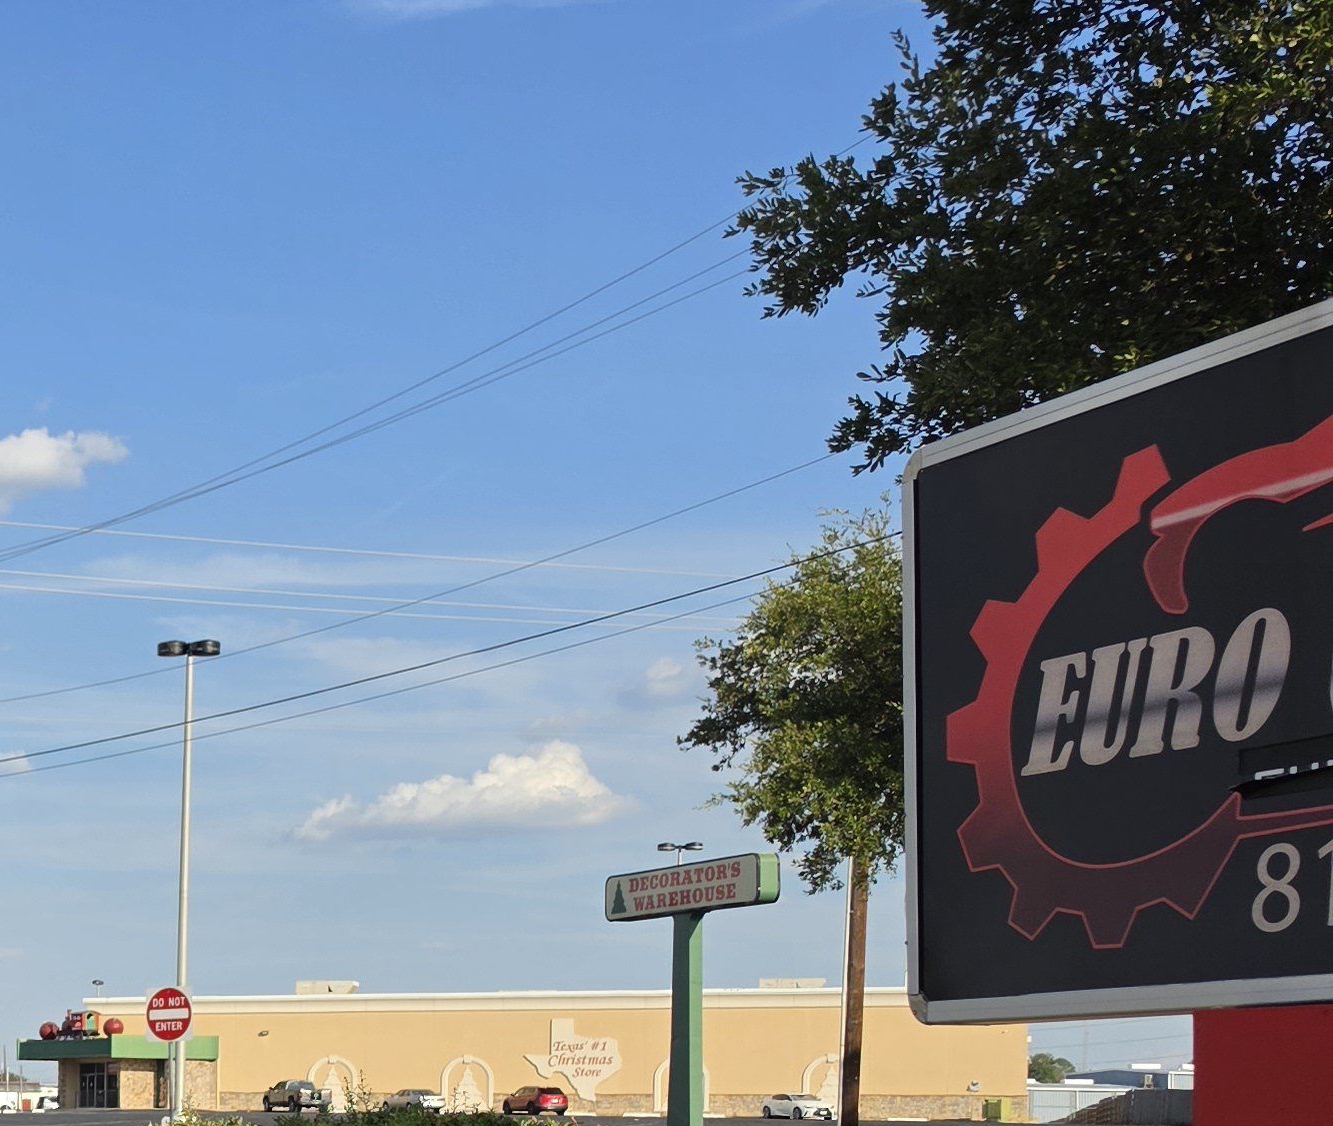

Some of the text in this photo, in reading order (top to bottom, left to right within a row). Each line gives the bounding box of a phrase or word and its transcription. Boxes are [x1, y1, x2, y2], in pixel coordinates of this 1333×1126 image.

[1021, 606, 1291, 777] EURO
[628, 861, 741, 893] DECORATOR'S
[634, 883, 737, 912] WAREHOUSE
[152, 996, 186, 1008] DO NOT
[155, 1021, 183, 1032] ENTER
[553, 1040, 588, 1053] Texas'
[548, 1053, 614, 1067] Christmas
[572, 1067, 602, 1077] Store
